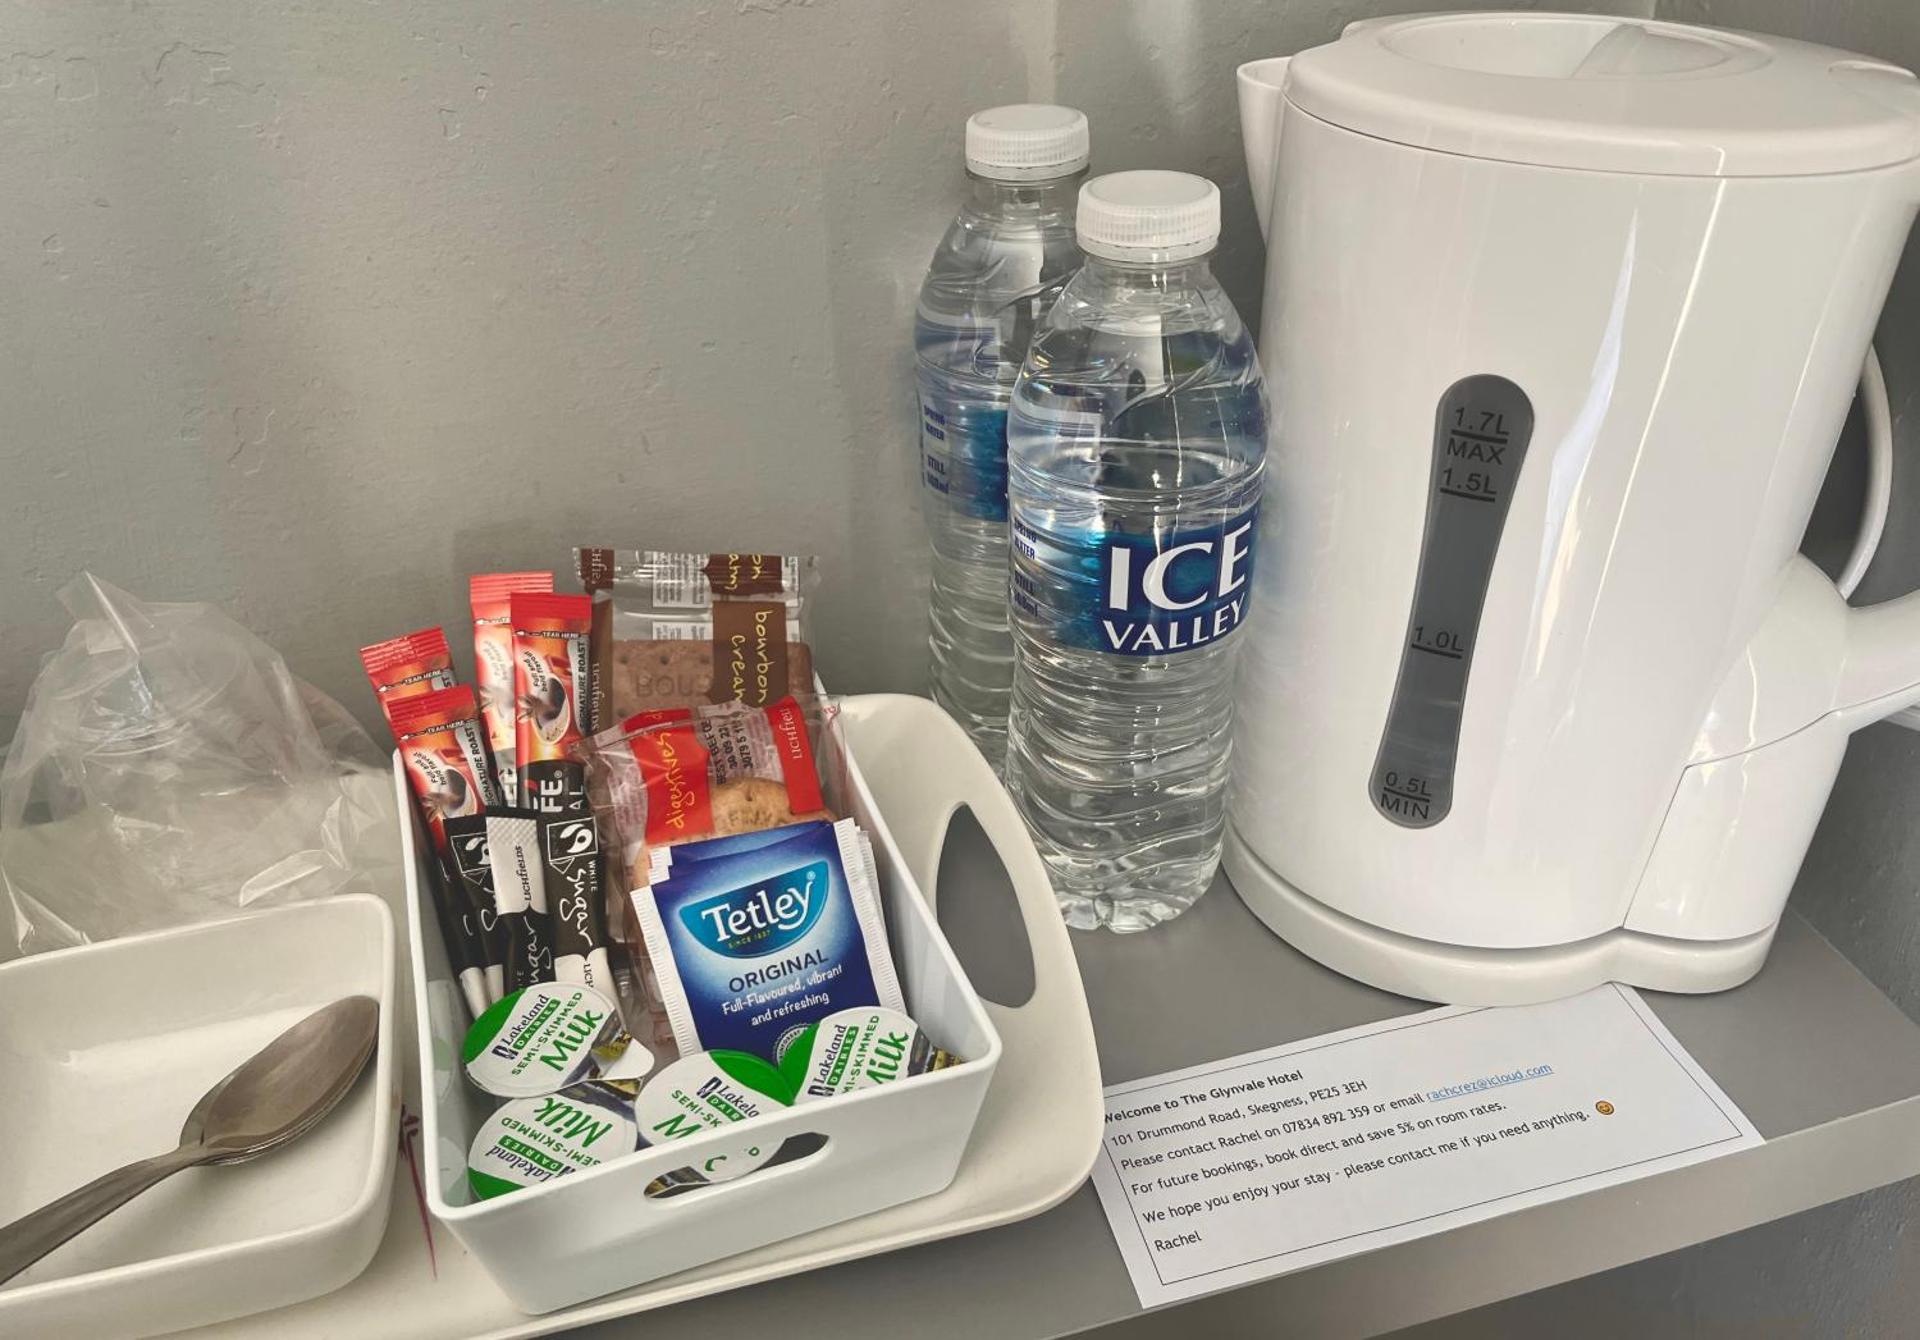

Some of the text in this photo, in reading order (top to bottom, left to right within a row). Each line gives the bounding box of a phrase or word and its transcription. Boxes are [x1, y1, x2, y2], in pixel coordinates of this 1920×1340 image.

[1454, 406, 1511, 436] 1.7L
[1447, 437, 1506, 466] MAX
[1442, 467, 1497, 495] 1.5L
[1108, 520, 1252, 612] ICE
[1102, 591, 1245, 651] VALLEY
[1415, 626, 1464, 653] 1.0L
[577, 641, 586, 673] ROAST
[731, 635, 746, 703] cream
[755, 610, 773, 703] bourbon
[465, 726, 480, 755] ROAST
[655, 732, 695, 829] digestives
[1380, 793, 1429, 820] MIN
[1385, 772, 1432, 797] 0.5L
[701, 880, 815, 942] Tetley
[523, 915, 551, 982] ugar
[729, 948, 829, 993] ORIGINAL
[807, 964, 843, 987] vibrant
[503, 993, 551, 1046] Lakeland
[512, 991, 583, 1076] SEMI-SKIMMED
[516, 1000, 560, 1048] DAIRIES
[751, 992, 831, 1027] and refreshing
[539, 1009, 604, 1072] Milk
[814, 1024, 848, 1084] Lakeland
[832, 1029, 857, 1083] DAIRIES
[842, 1015, 880, 1094] MI-SKIMMED
[533, 1097, 613, 1148] Milk
[671, 1089, 722, 1128] SEMI-SK
[710, 1098, 739, 1121] DAIR
[1104, 1070, 1304, 1124] Welcome to The Glynvale Hotel
[1111, 1080, 1368, 1147] 101 Drummond Road, Skegness, PE25 3EH
[1121, 1063, 1555, 1171] Please contact Rachel on 07834 892 359 or email rachcrez@icloud.com
[485, 1145, 552, 1182] Lakeland
[502, 1138, 560, 1170] DAIRIES
[1131, 1101, 1506, 1196] For future bookings, book direct and save 5% on room rates.
[1142, 1210, 1165, 1224] We
[1168, 1200, 1202, 1218] hope
[1204, 1195, 1230, 1211] you
[1233, 1185, 1270, 1203] enjoy
[1272, 1177, 1301, 1194] your
[1304, 1170, 1332, 1185] stay
[1343, 1158, 1385, 1179] please
[1387, 1146, 1437, 1166] contact
[1438, 1141, 1459, 1154] me
[1460, 1136, 1471, 1148] if
[1473, 1132, 1498, 1148] you
[1499, 1123, 1530, 1139] need
[1532, 1108, 1590, 1131] anything.
[1154, 1230, 1202, 1252] Rachel
